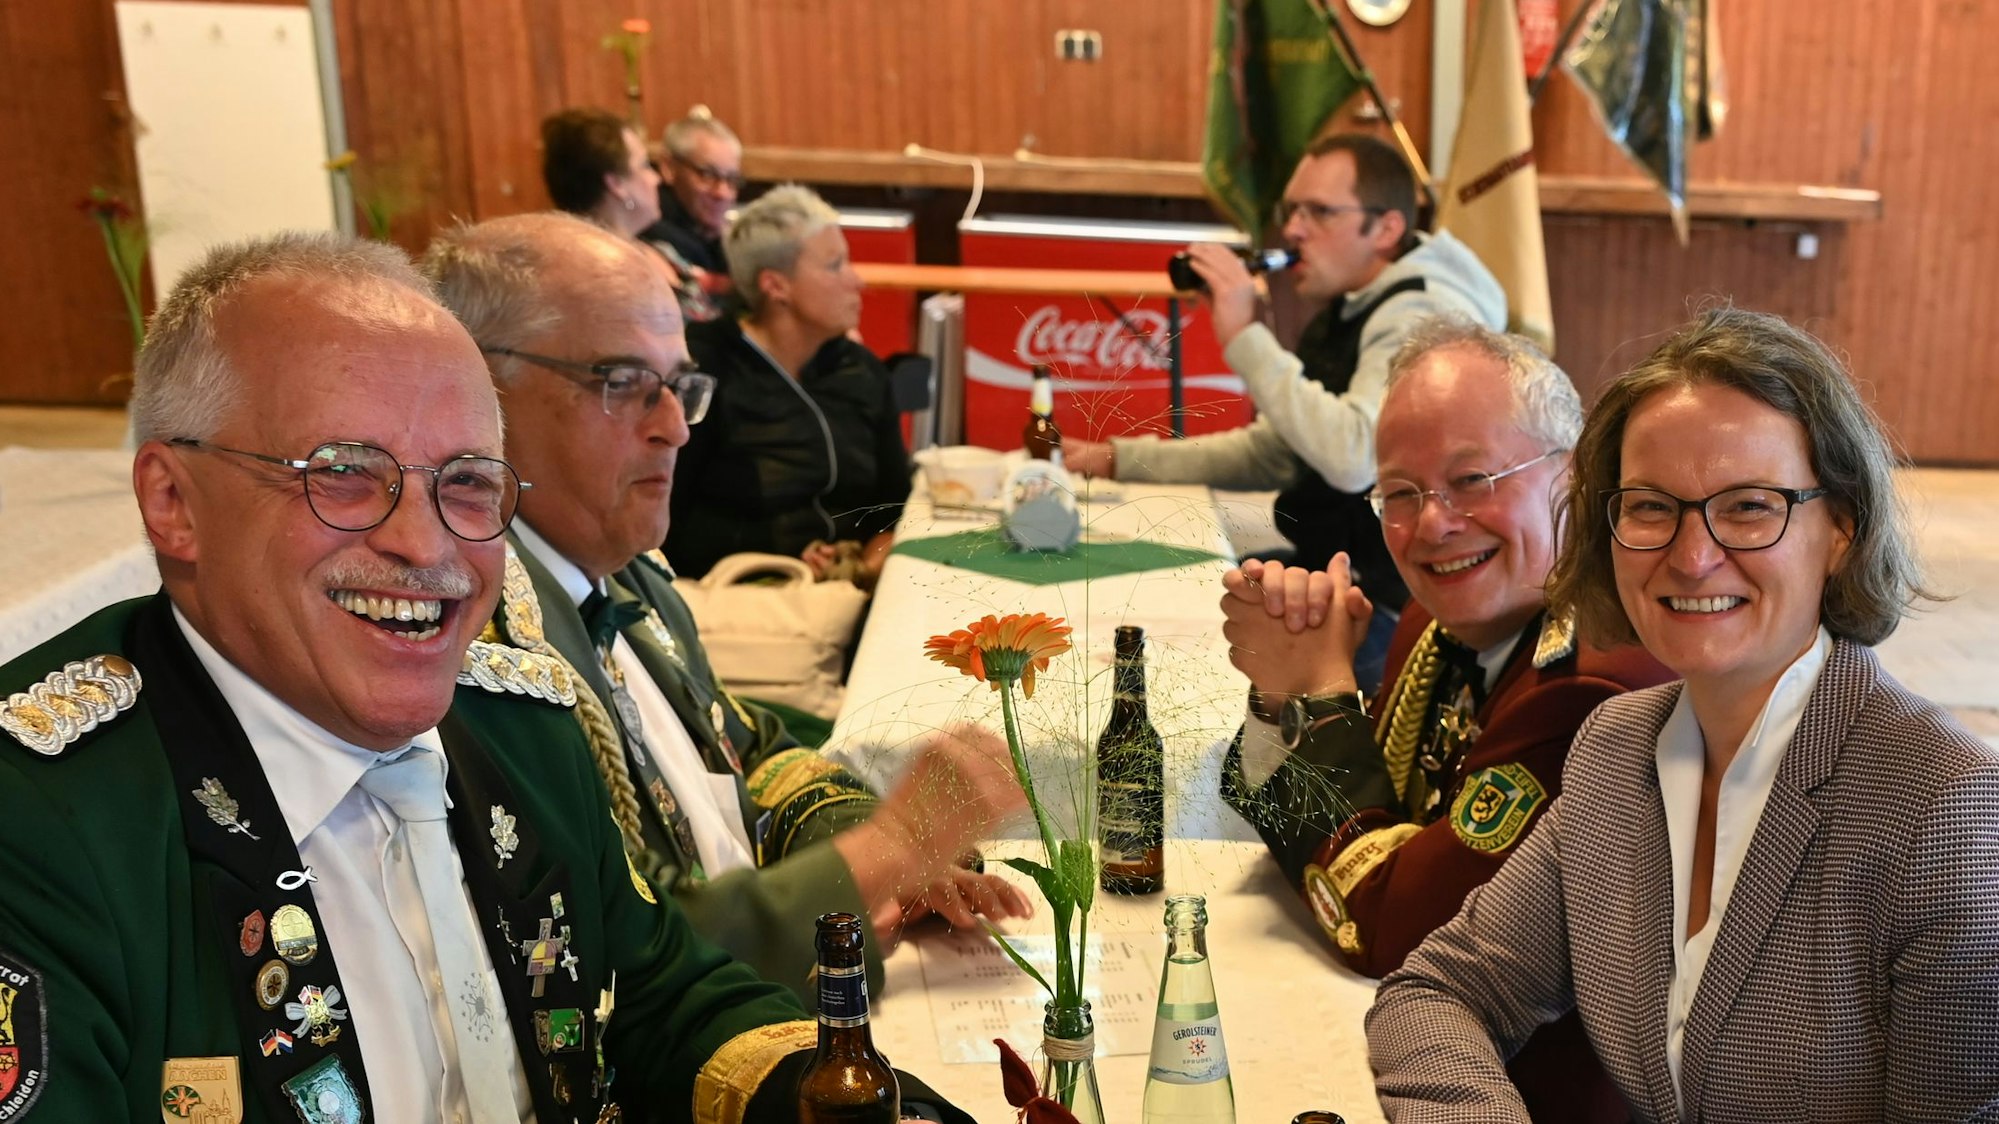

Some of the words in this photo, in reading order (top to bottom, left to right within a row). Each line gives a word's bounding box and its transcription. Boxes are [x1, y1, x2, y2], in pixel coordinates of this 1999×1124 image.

[1502, 763, 1540, 800] D-EIFEL
[0, 965, 30, 987] rat
[1172, 1025, 1218, 1042] GEROLSTEINER
[1182, 1056, 1213, 1065] SPRUDEL
[168, 1070, 228, 1082] AACHEN
[0, 1069, 40, 1120] chleiden
